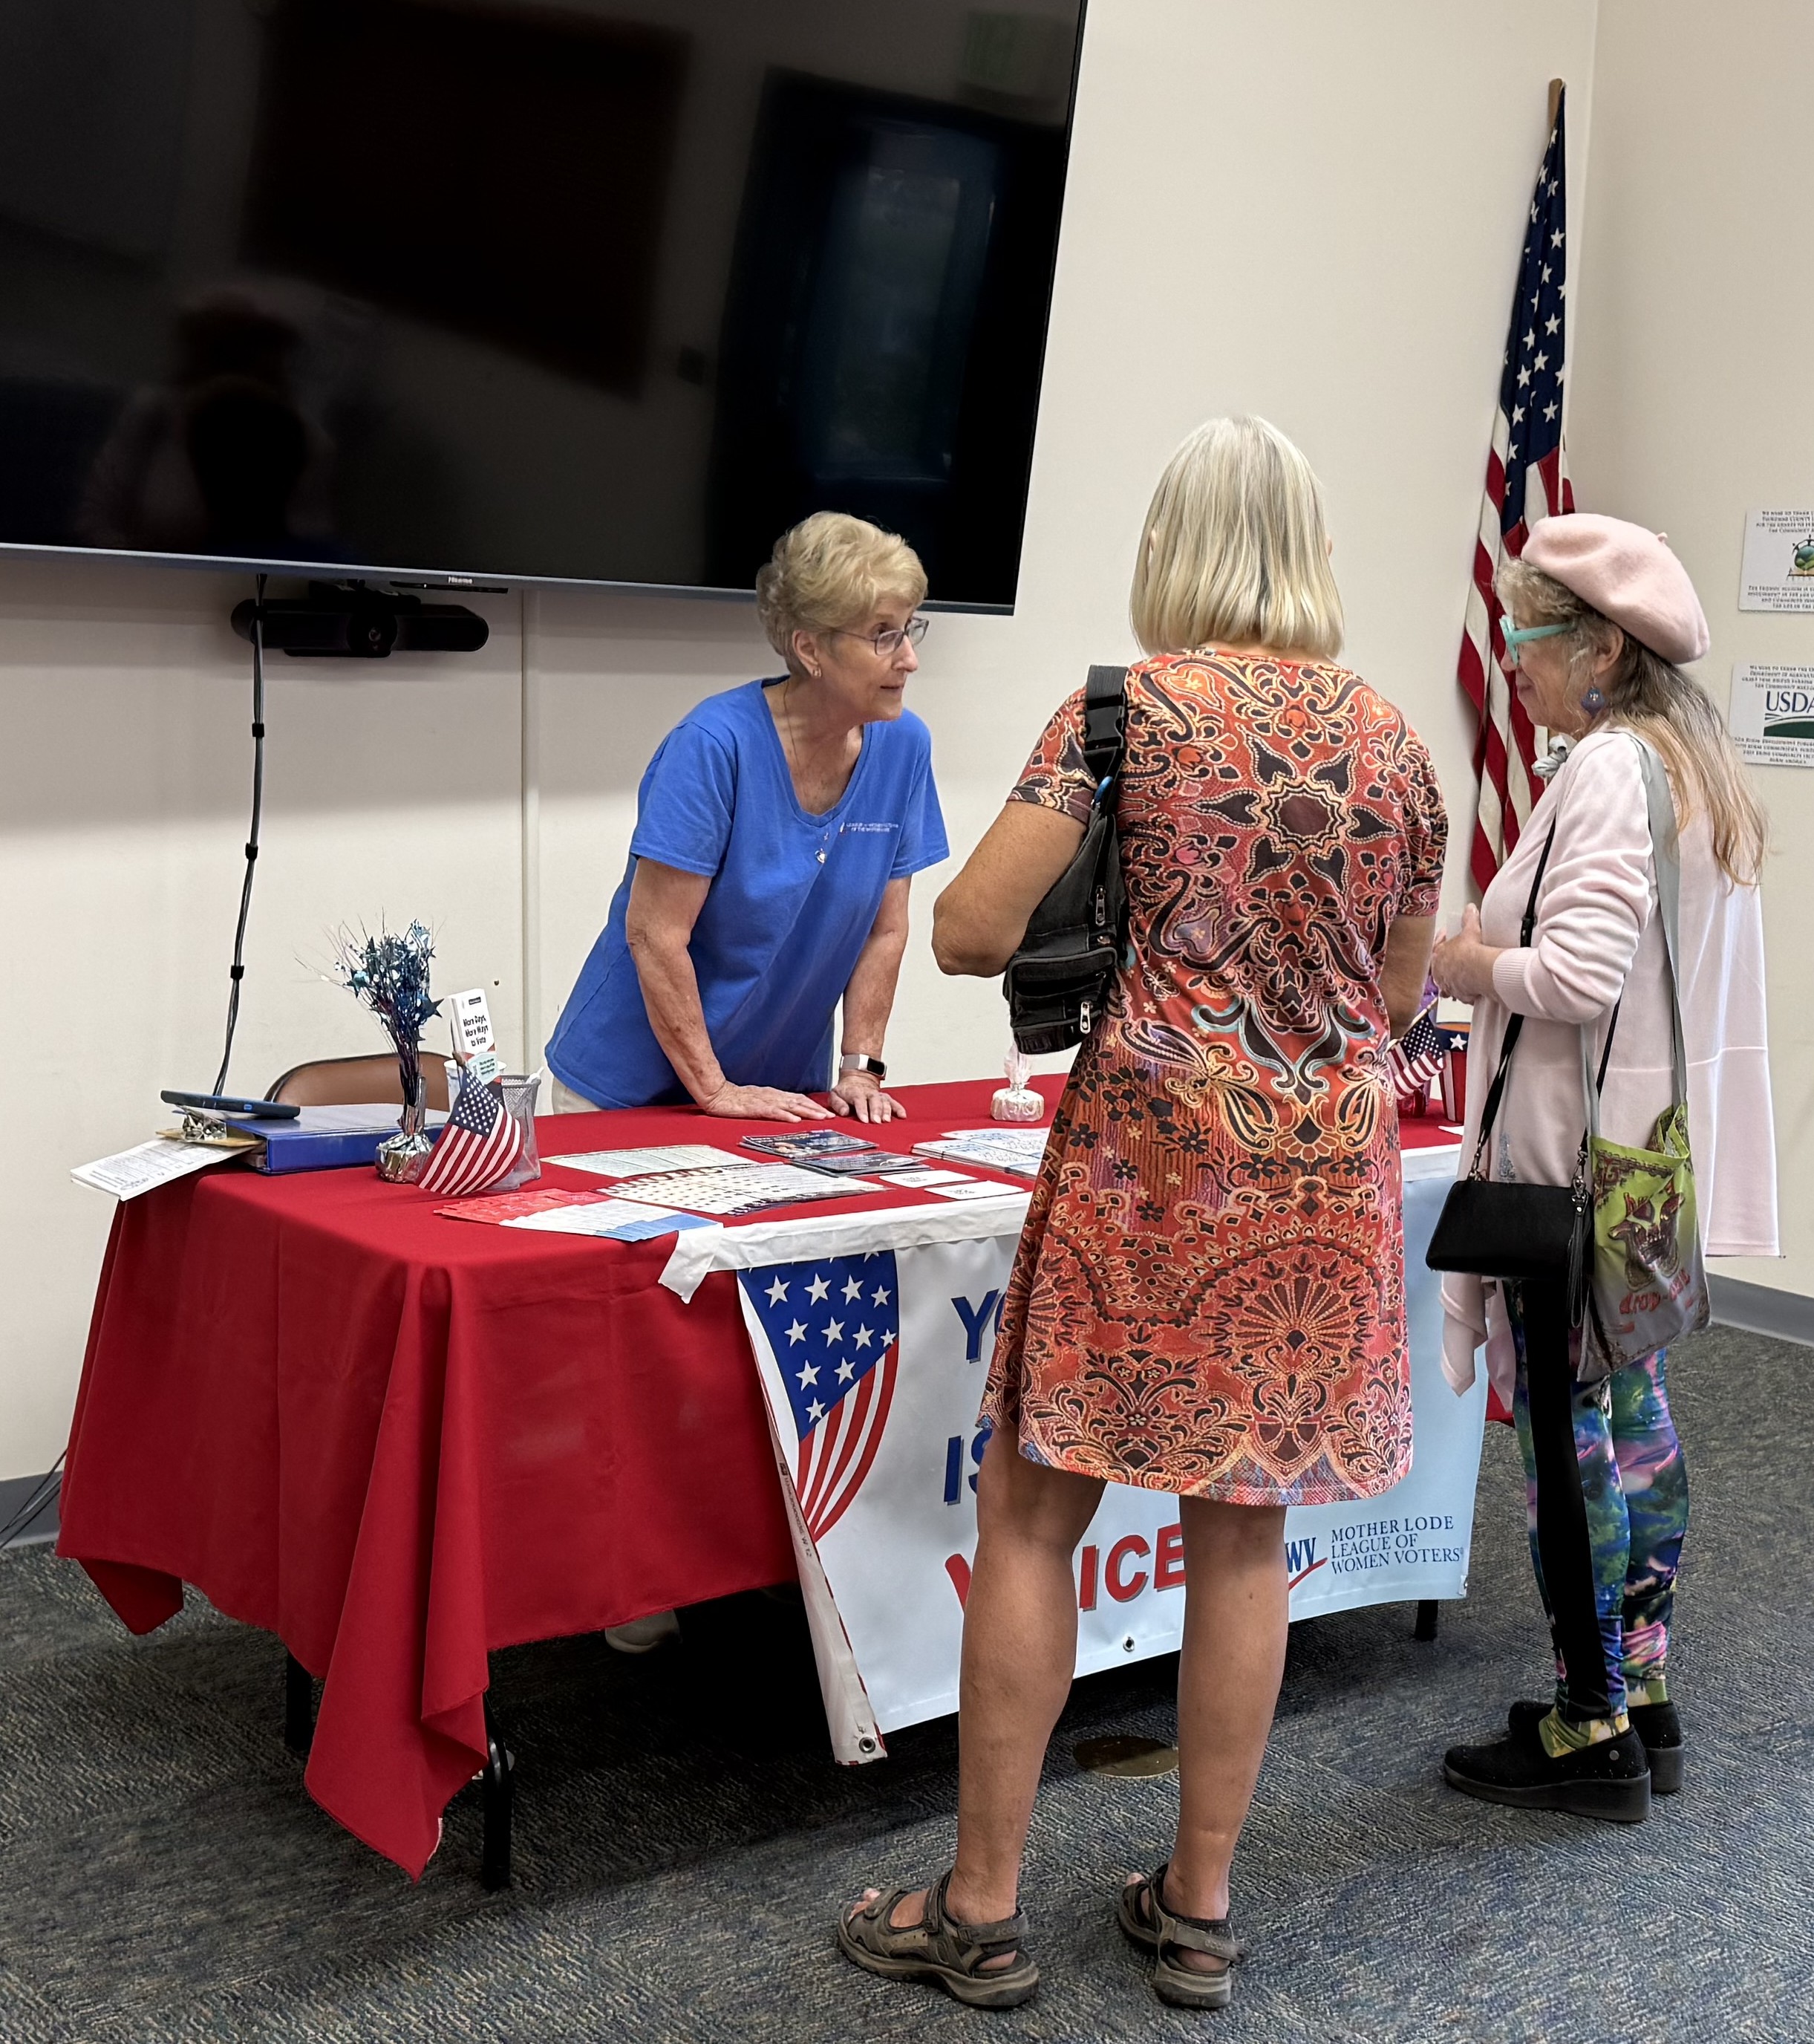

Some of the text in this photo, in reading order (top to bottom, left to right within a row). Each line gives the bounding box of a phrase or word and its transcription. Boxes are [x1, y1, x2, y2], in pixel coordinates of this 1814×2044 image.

[1331, 1516, 1455, 1543] MOTHER LODE
[1331, 1533, 1418, 1559] LEAGUE OF
[1331, 1552, 1390, 1575] WOMEN
